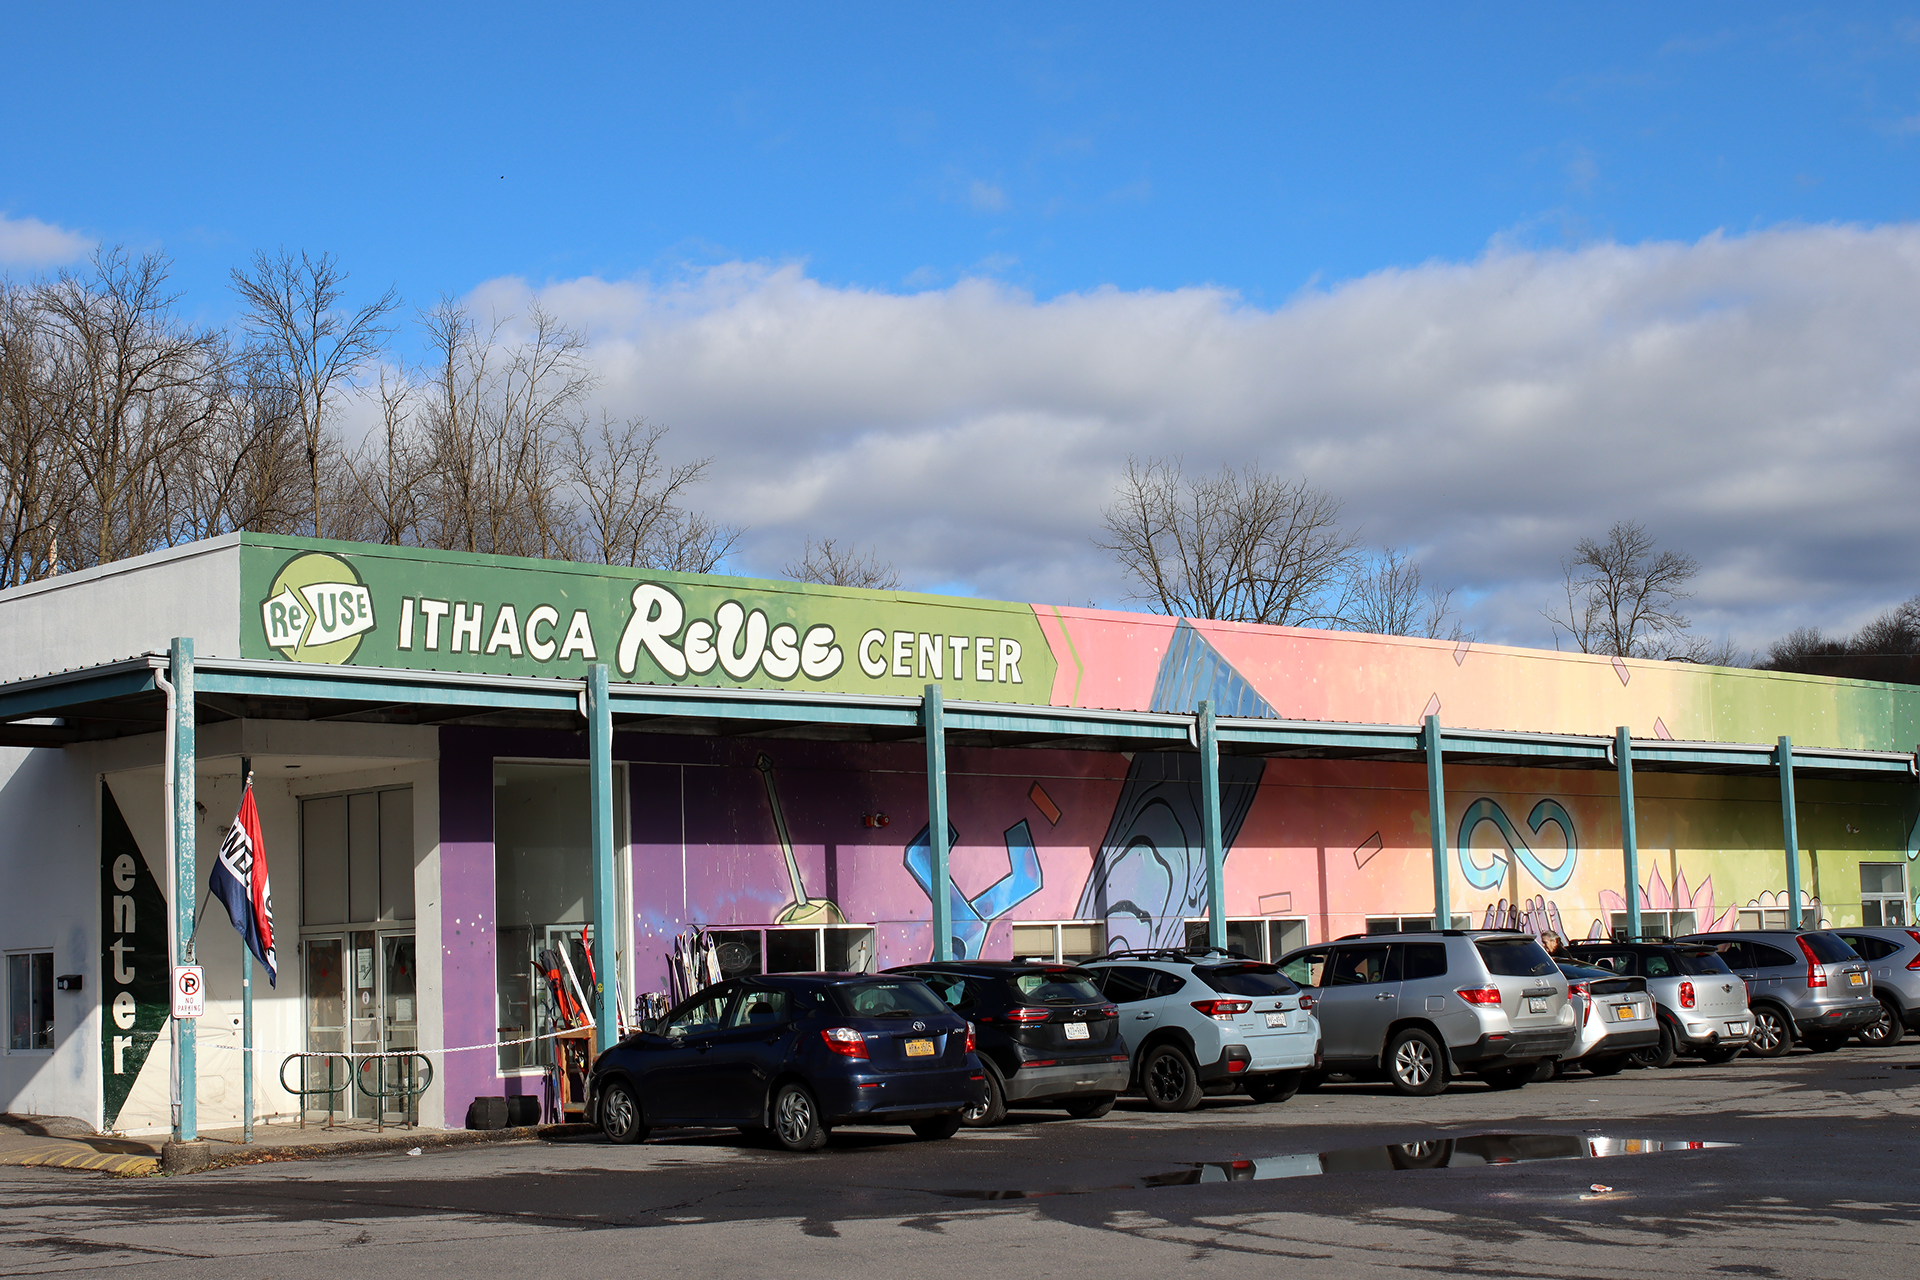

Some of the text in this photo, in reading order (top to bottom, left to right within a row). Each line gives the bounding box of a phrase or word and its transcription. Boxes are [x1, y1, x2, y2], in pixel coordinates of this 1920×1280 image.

[269, 590, 368, 638] Re USE
[398, 596, 599, 662] ITHACA
[858, 628, 1024, 684] CENTER
[109, 853, 137, 1074] enter
[177, 1004, 201, 1012] PARKING
